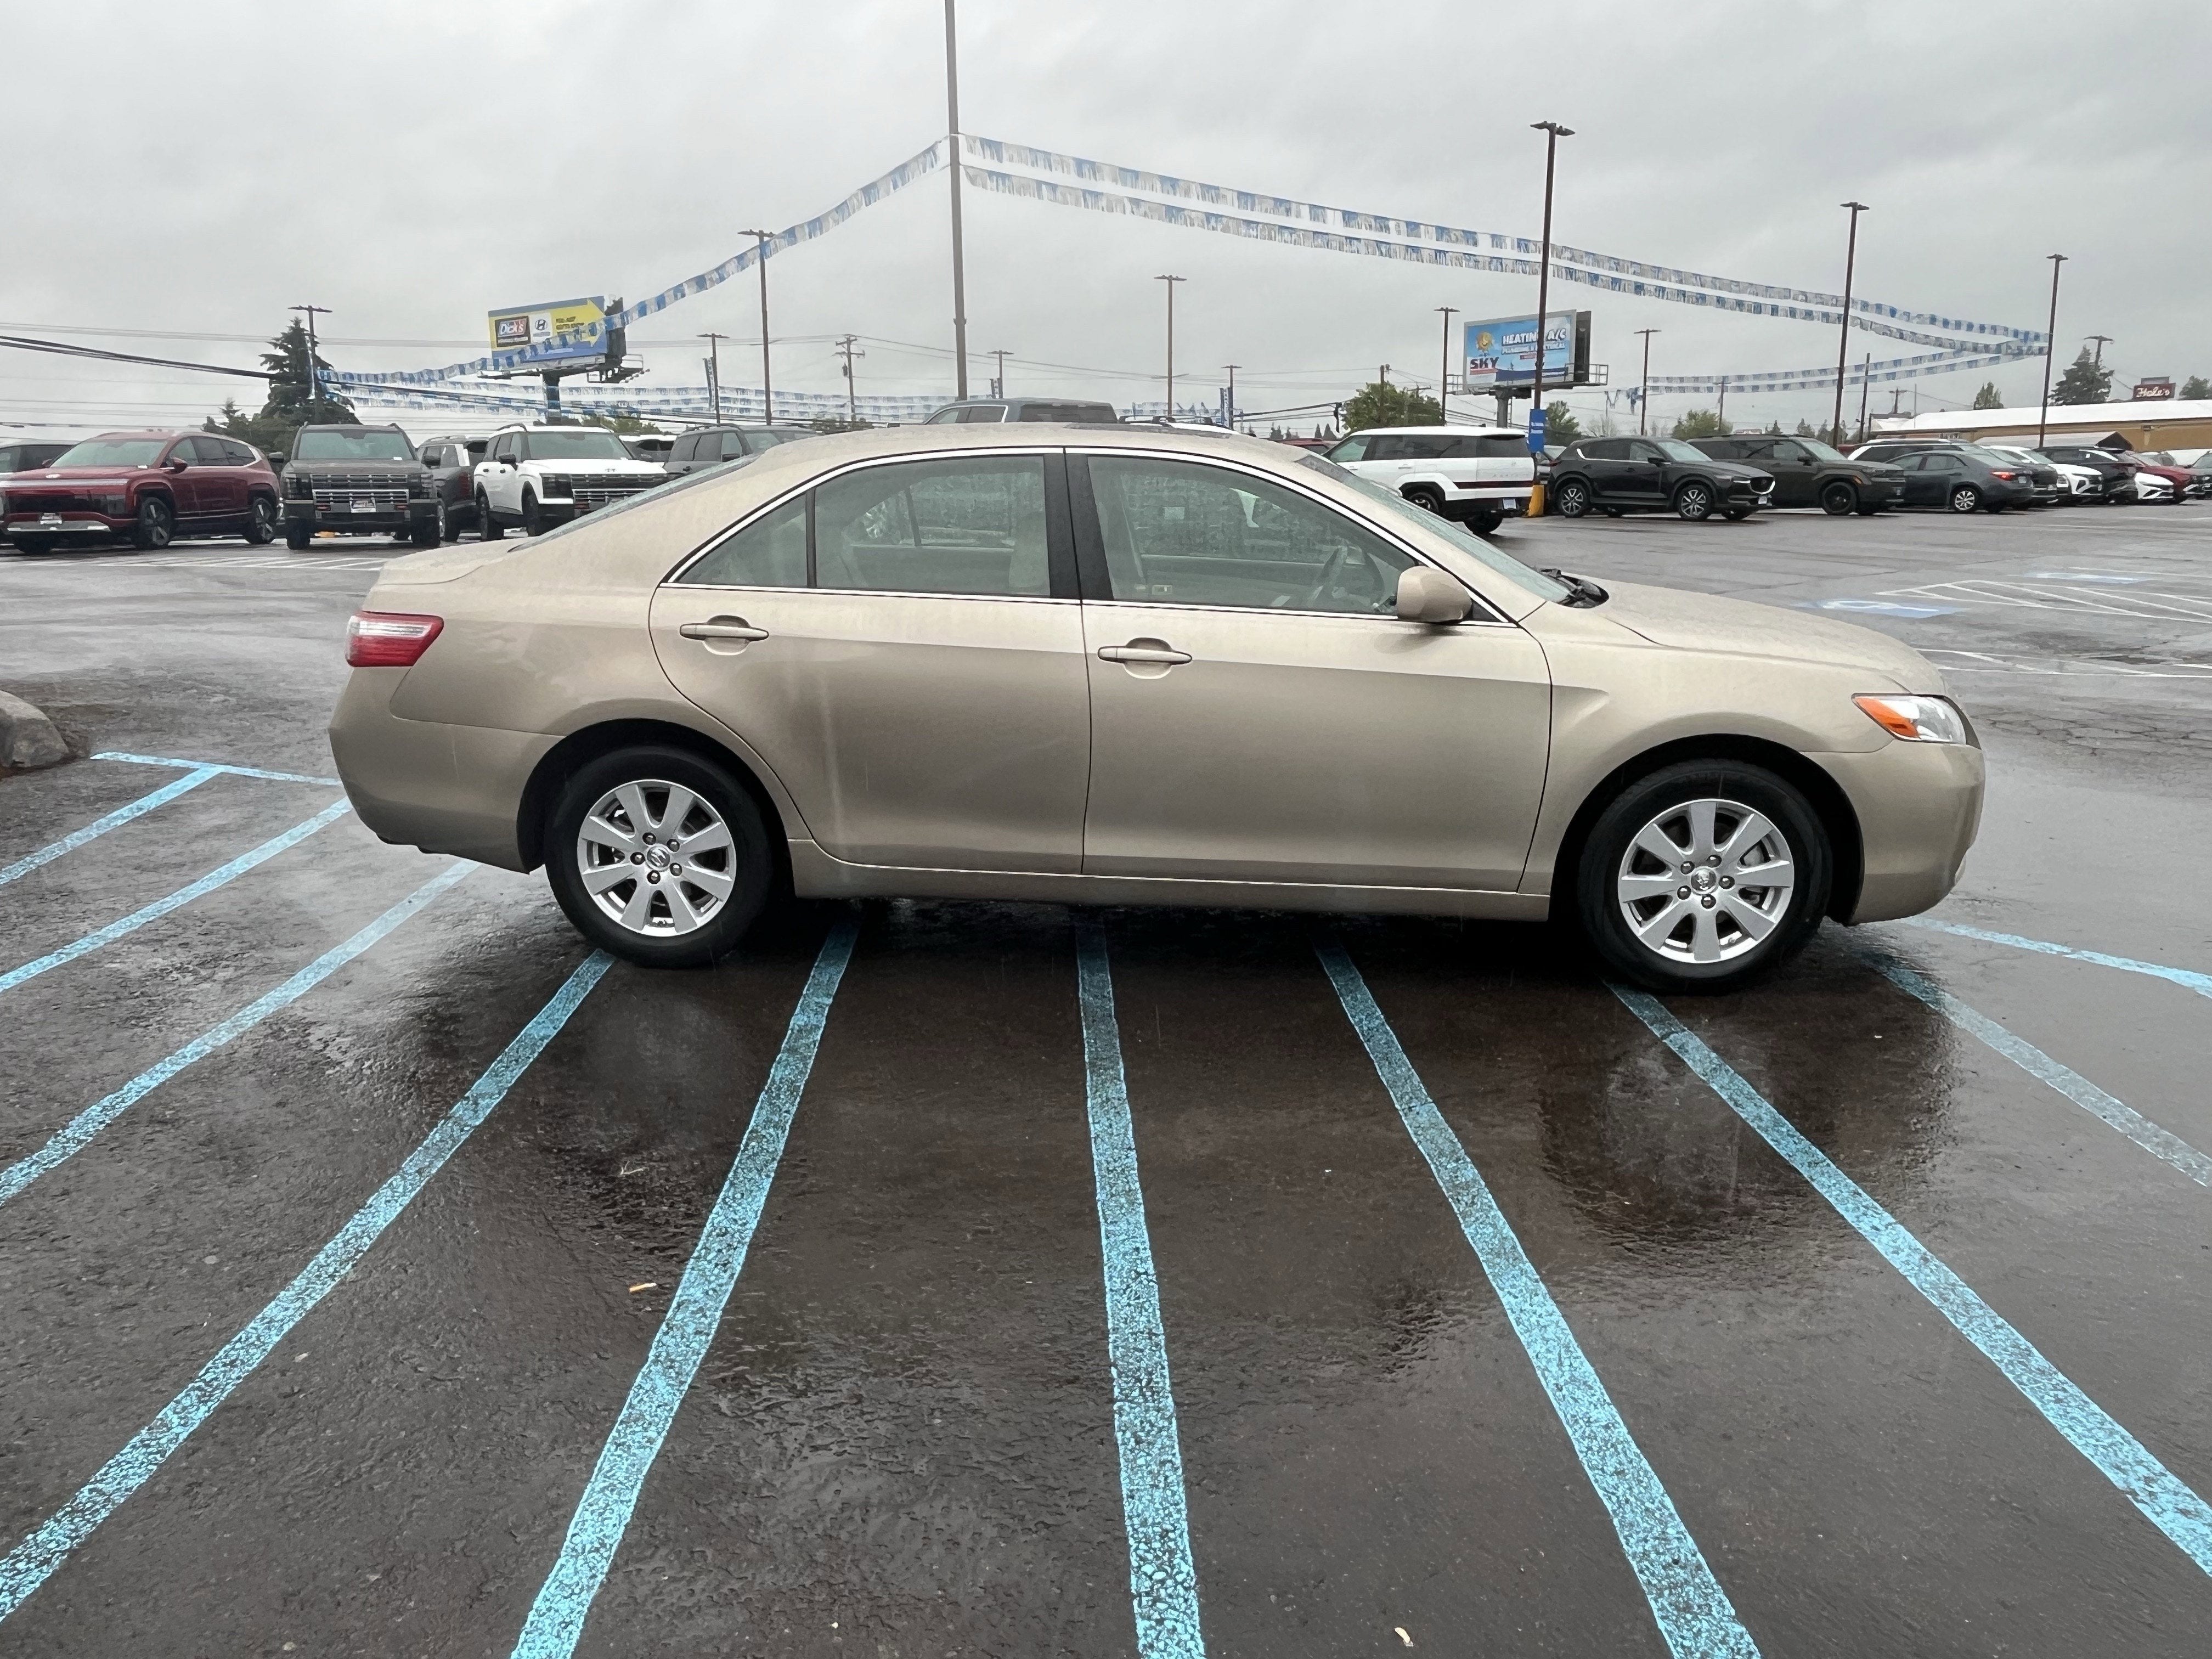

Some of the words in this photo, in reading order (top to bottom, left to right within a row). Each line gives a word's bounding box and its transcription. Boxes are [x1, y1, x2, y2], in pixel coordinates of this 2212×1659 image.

[1502, 332, 1539, 346] HEATIN
[1546, 328, 1566, 342] A/C
[1470, 357, 1499, 369] SKY
